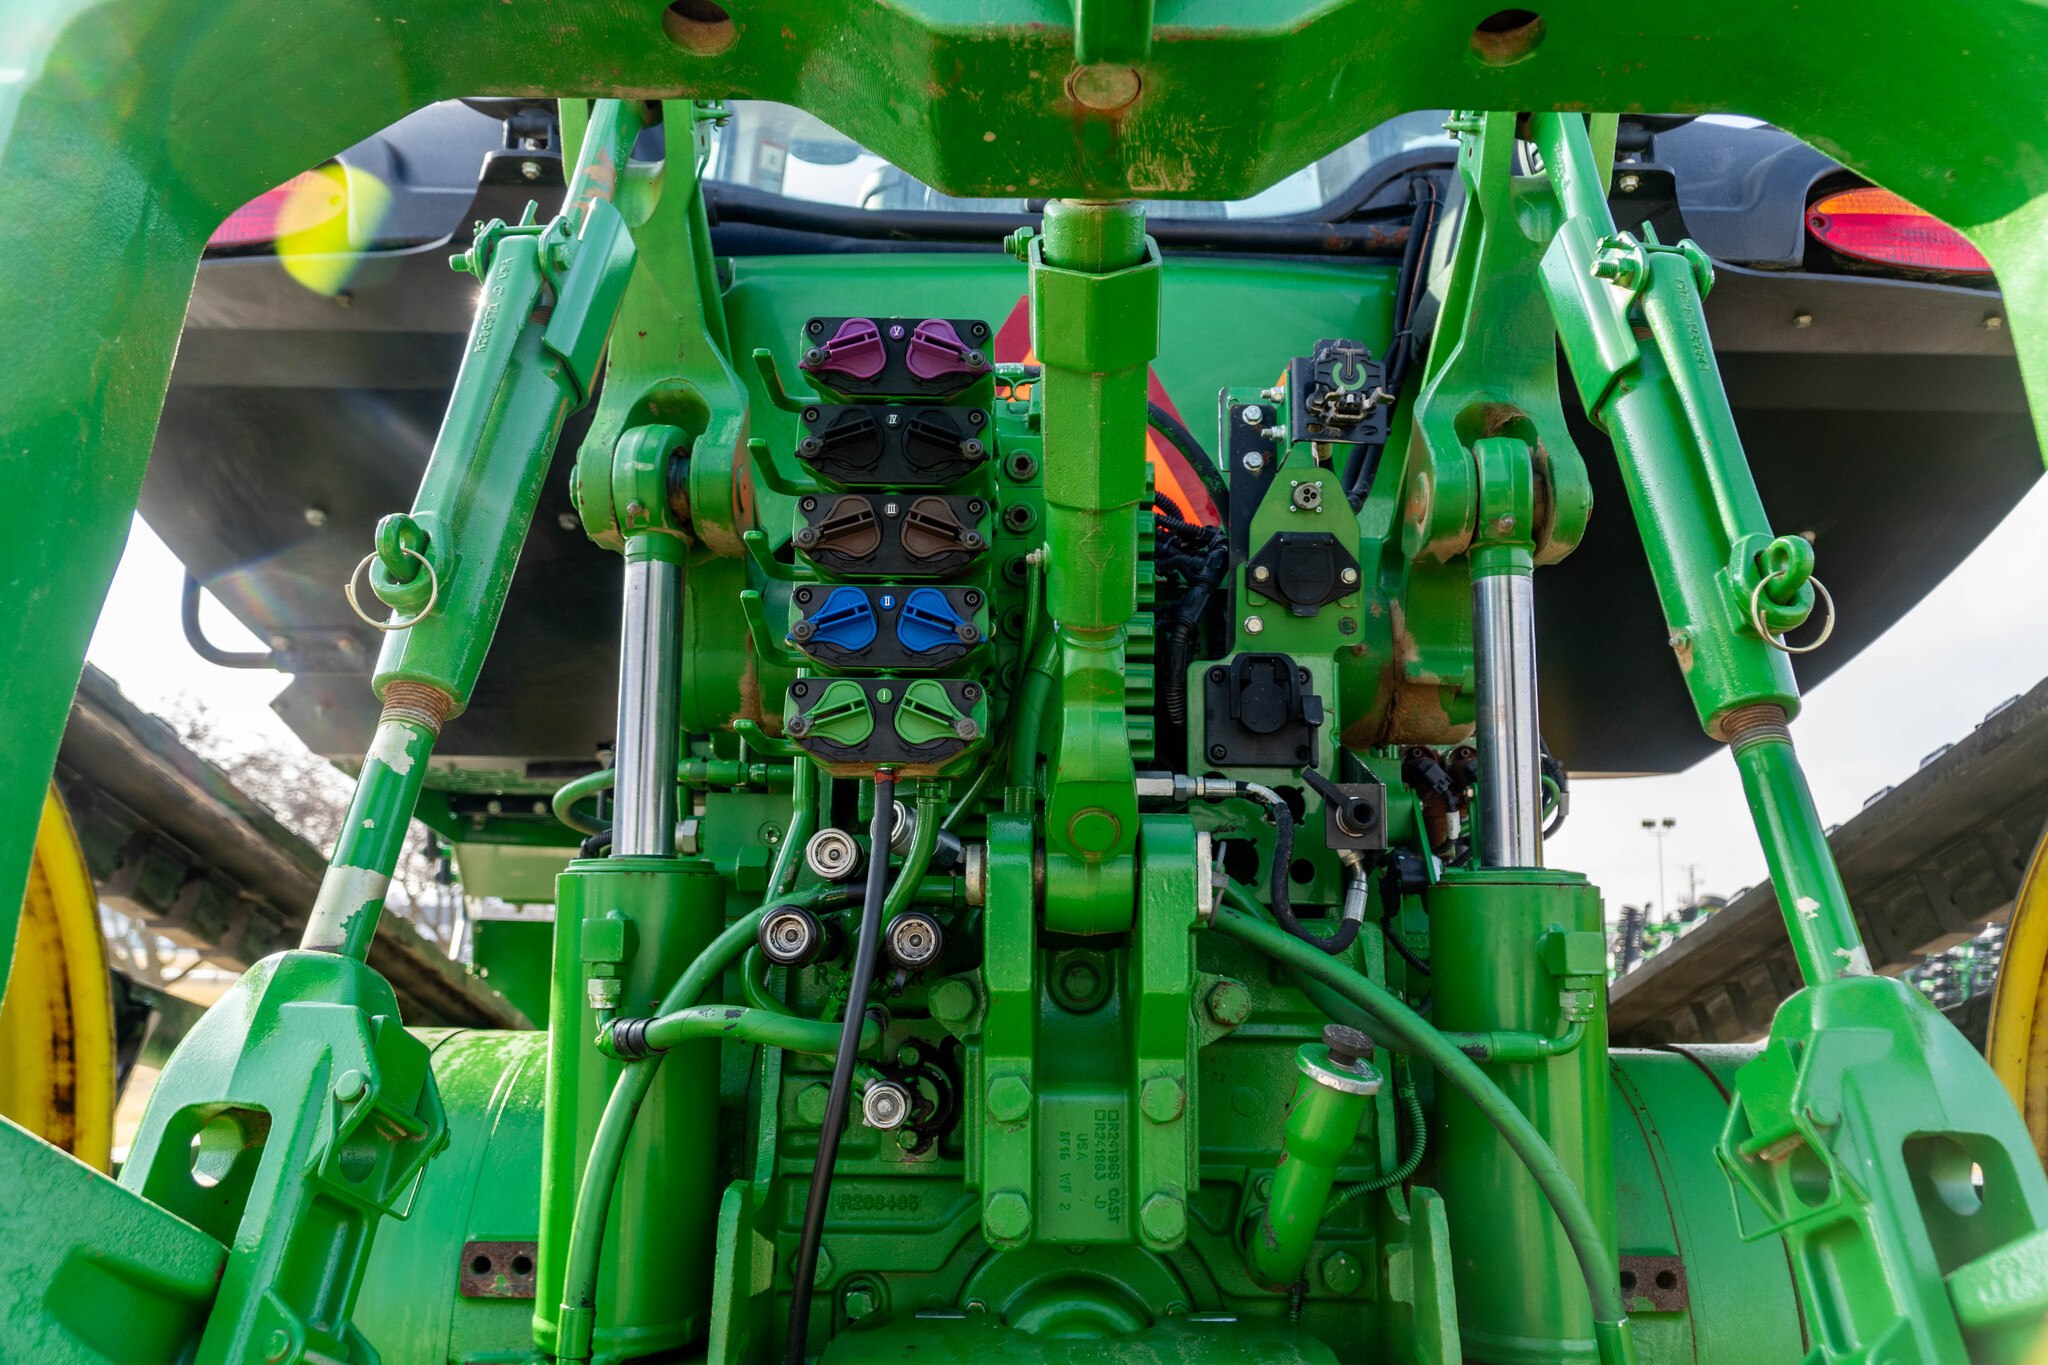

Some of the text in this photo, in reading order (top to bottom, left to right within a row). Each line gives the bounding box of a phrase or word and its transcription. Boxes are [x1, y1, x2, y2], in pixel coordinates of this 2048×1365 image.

[892, 326, 903, 336] V
[888, 414, 898, 424] IV
[887, 504, 897, 514] III
[884, 596, 891, 607] II
[1076, 1133, 1089, 1162] USA
[1059, 1202, 1072, 1213] 2
[1108, 1187, 1121, 1225] CAST
